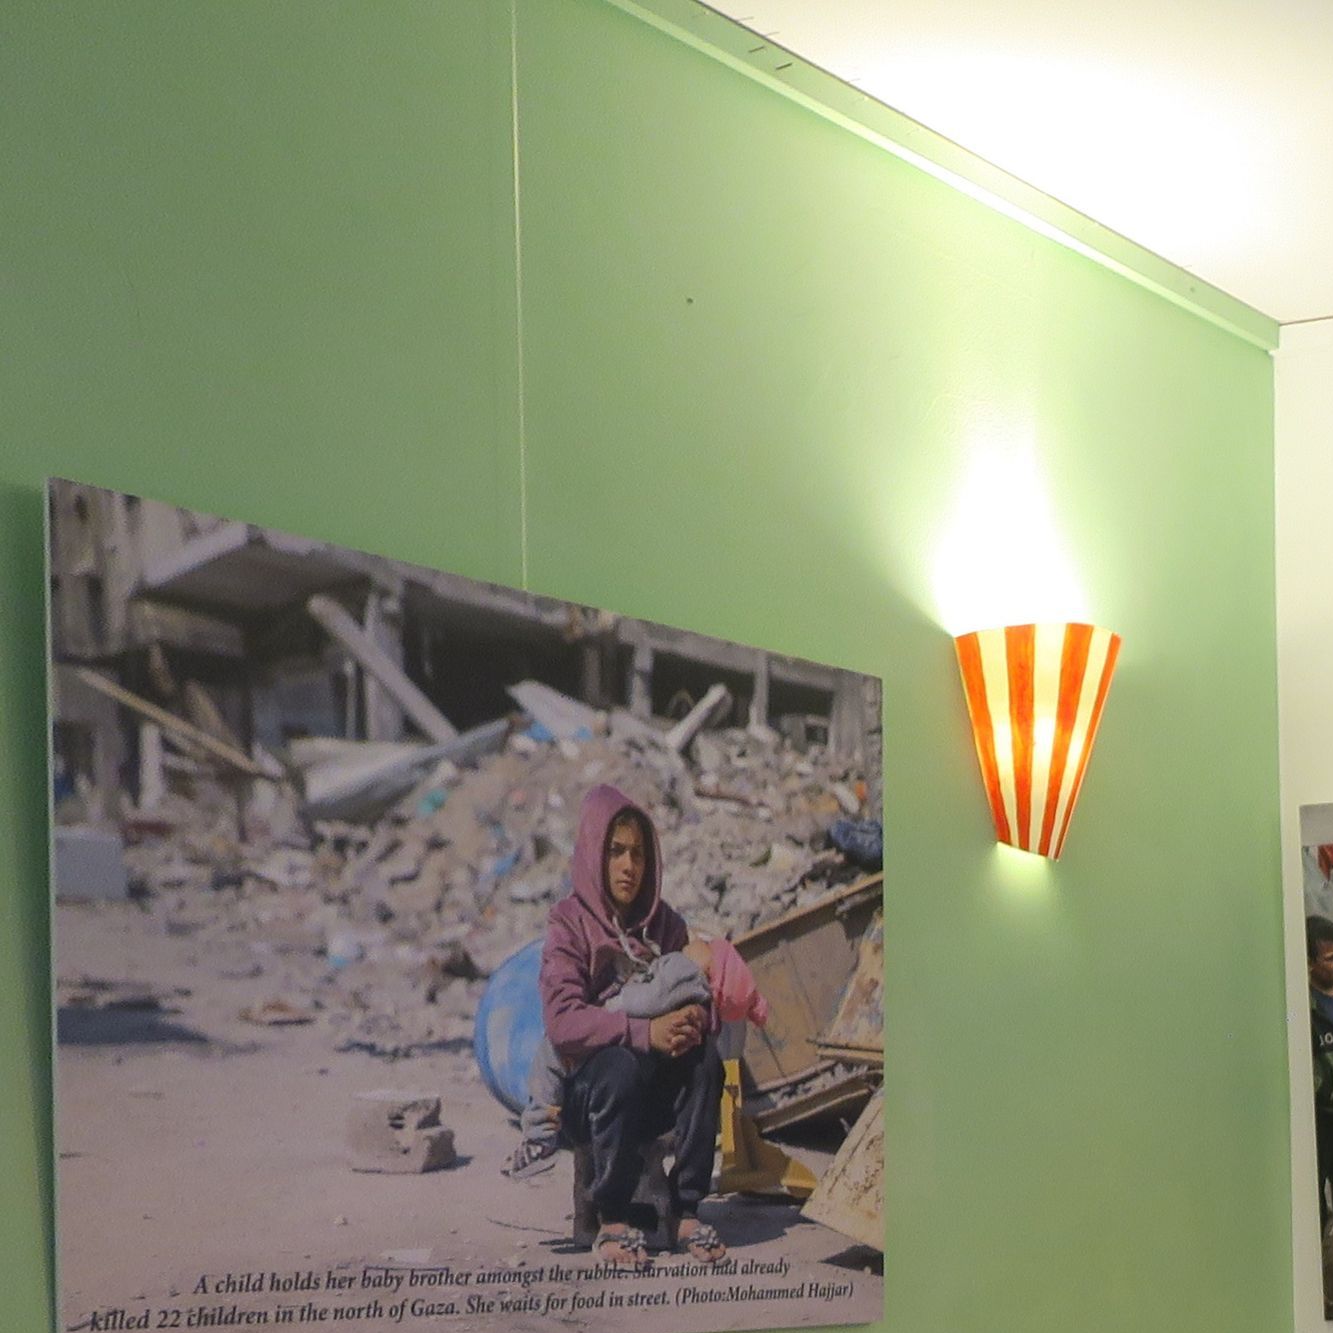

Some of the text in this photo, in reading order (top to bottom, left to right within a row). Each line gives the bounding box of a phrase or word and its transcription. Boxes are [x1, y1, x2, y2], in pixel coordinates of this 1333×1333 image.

[193, 1257, 791, 1295] A child holds her baby brother amongst the rubble. Starvation had already
[90, 1280, 855, 1333] killed 22 children in the north of Gaza. She waits for food in street. (Photo:Mohammed Hajjar)
